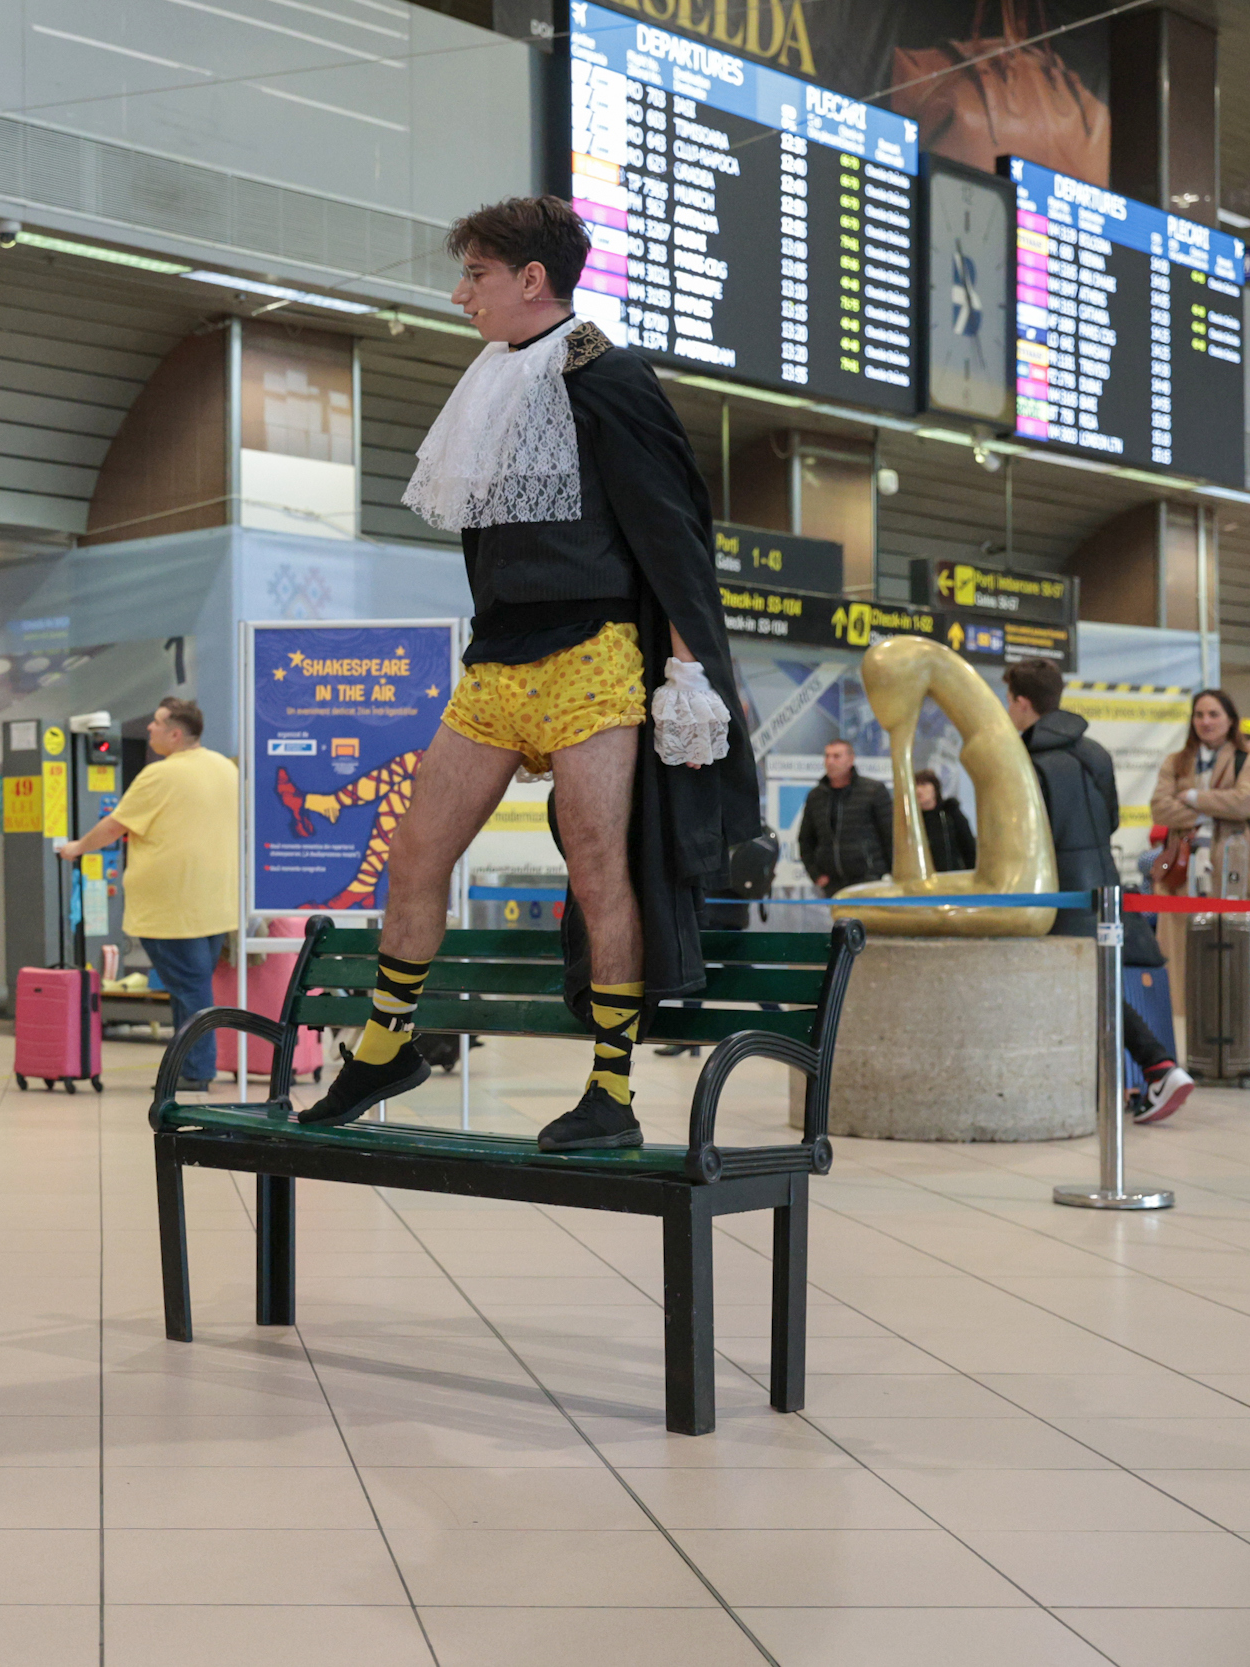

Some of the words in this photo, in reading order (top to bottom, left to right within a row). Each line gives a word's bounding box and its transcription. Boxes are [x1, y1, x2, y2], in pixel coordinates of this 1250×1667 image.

[616, 0, 818, 77] ELDA
[637, 23, 745, 86] DEPARTURES
[1054, 173, 1127, 221] DEPARTURES
[715, 552, 741, 572] Gates
[724, 612, 756, 633] heck-in
[871, 608, 912, 631] Check-in
[302, 658, 410, 677] SHAKESPEARE
[315, 684, 331, 702] IN
[337, 684, 365, 702] THE
[371, 684, 396, 702] AIR
